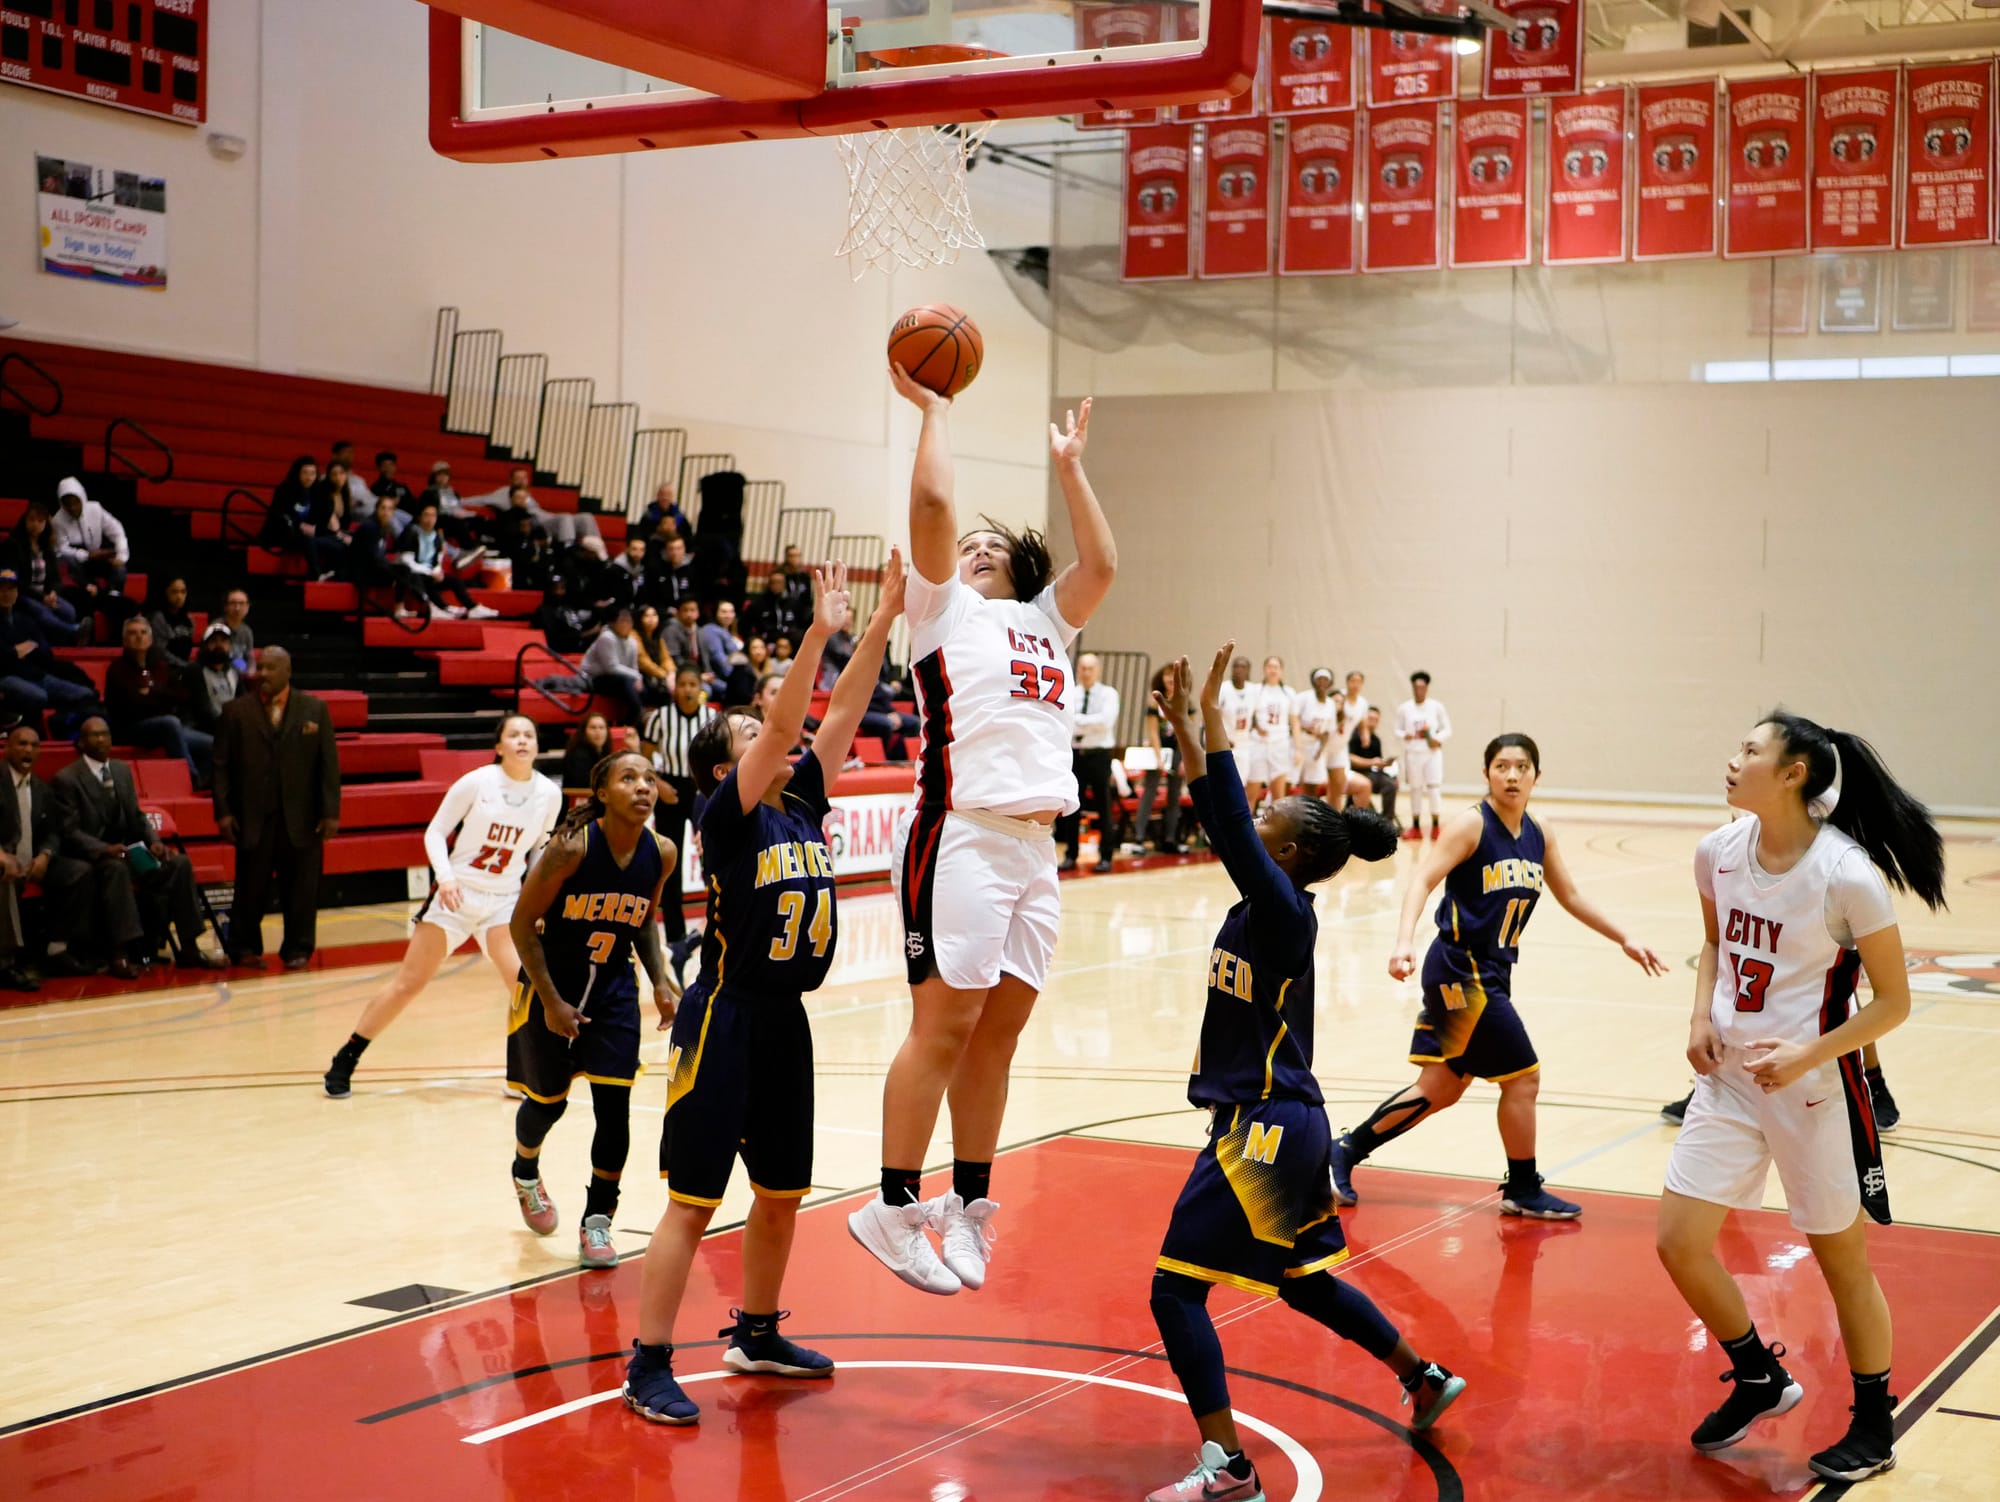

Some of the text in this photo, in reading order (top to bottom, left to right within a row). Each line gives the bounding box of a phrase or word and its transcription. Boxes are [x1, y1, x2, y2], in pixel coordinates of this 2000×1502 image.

[0, 10, 31, 29] FOULS
[73, 30, 133, 55] PLAYER FOUL
[0, 62, 31, 80] SCORE
[172, 55, 200, 72] FOULS
[86, 83, 118, 100] MATCH
[1292, 85, 1328, 106] 2014
[1394, 73, 1429, 96] 2015
[1913, 79, 1984, 100] CONFERENCE
[172, 103, 200, 121] SCORE
[1916, 93, 1980, 114] CHAMPIONS
[51, 207, 71, 223] ALL
[74, 211, 113, 231] SPORTS
[1010, 659, 1065, 711] 32
[487, 821, 525, 845] CITY
[850, 805, 906, 857] RAM
[468, 844, 514, 875] 23
[768, 887, 833, 961] 34
[1498, 898, 1530, 949] 11
[1725, 907, 1784, 954] CITY
[586, 931, 616, 964] 3
[1729, 951, 1775, 1013] 13
[1440, 982, 1468, 1011] M
[1242, 1121, 1284, 1165] M
